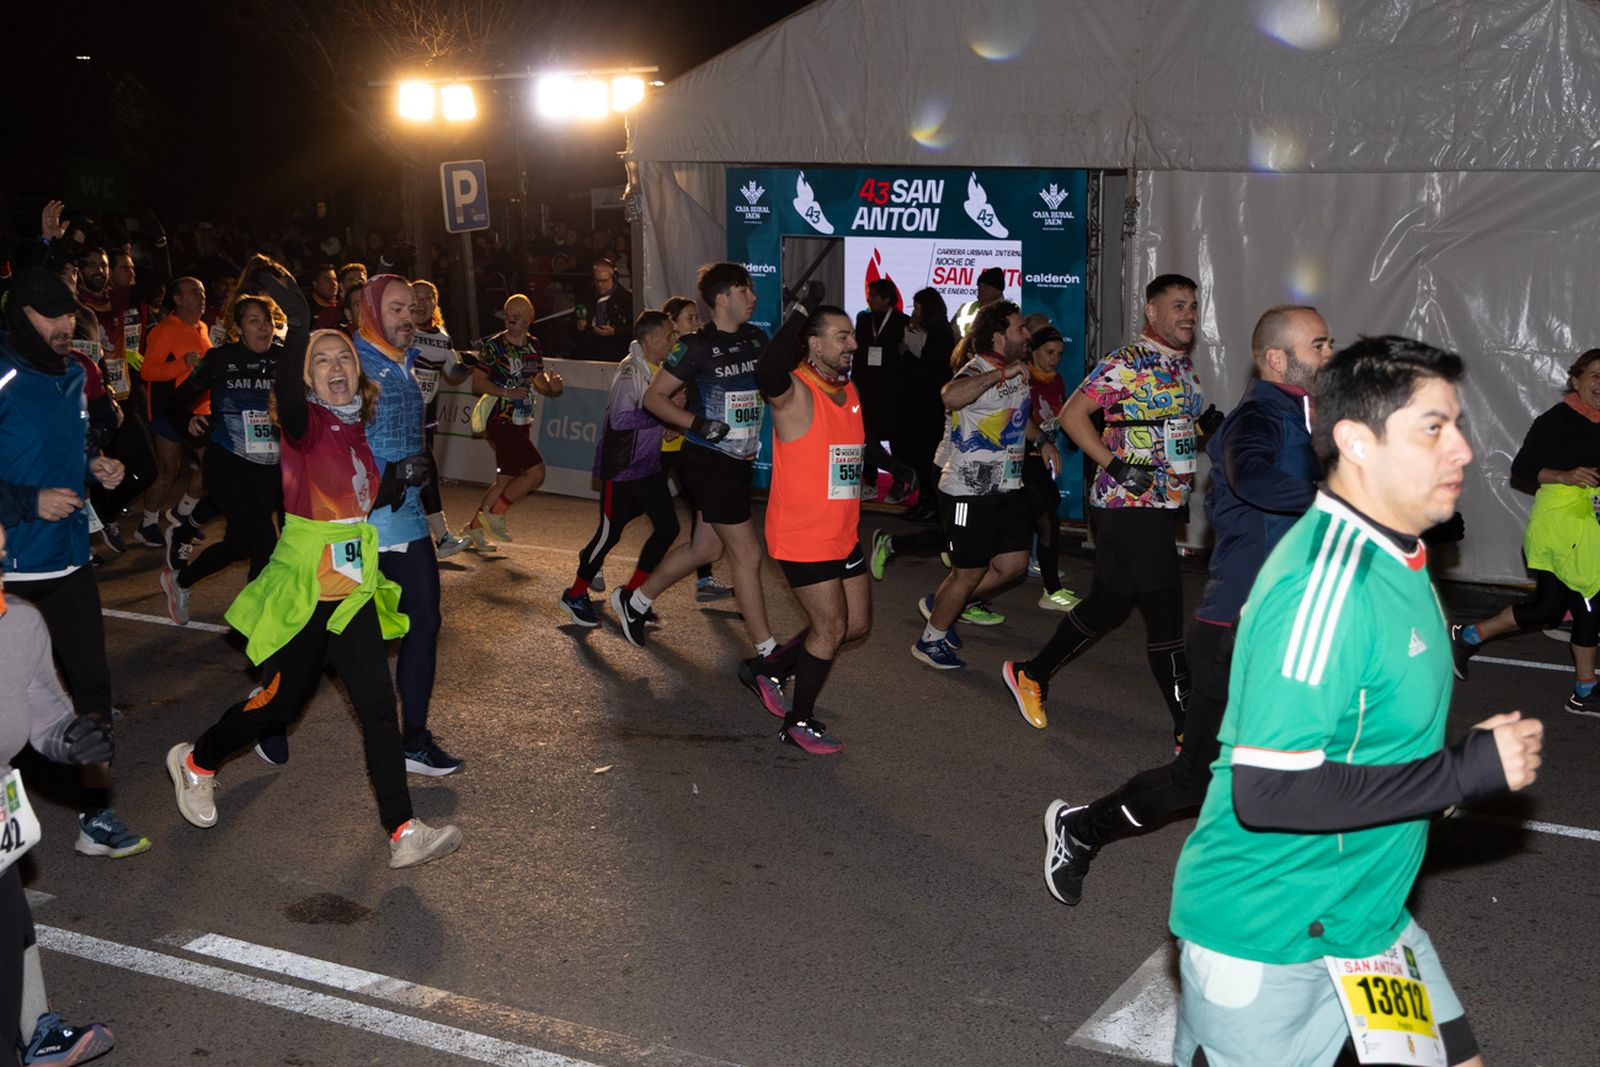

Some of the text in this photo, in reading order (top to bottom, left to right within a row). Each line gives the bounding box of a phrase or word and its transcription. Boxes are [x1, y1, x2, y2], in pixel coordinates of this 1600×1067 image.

[80, 176, 116, 197] WC
[890, 179, 945, 204] SAN
[452, 170, 478, 224] P
[735, 205, 771, 214] CAJA RURAL
[805, 205, 821, 224] 43
[851, 200, 940, 232] ANTÓN
[1032, 211, 1075, 220] CAJA RURAL
[976, 208, 994, 228] 43
[936, 248, 966, 256] CARRERA
[966, 249, 993, 257] URBANA
[935, 257, 976, 266] NOCHE DE
[932, 266, 974, 286] SAN
[1025, 273, 1080, 284] calderón
[947, 287, 969, 295] ENERO
[715, 363, 740, 378] SAN
[226, 378, 252, 390] SAN
[735, 407, 760, 423] 9045
[546, 415, 598, 443] alsa
[1344, 961, 1370, 974] SAN
[1357, 976, 1429, 1023] 13812
